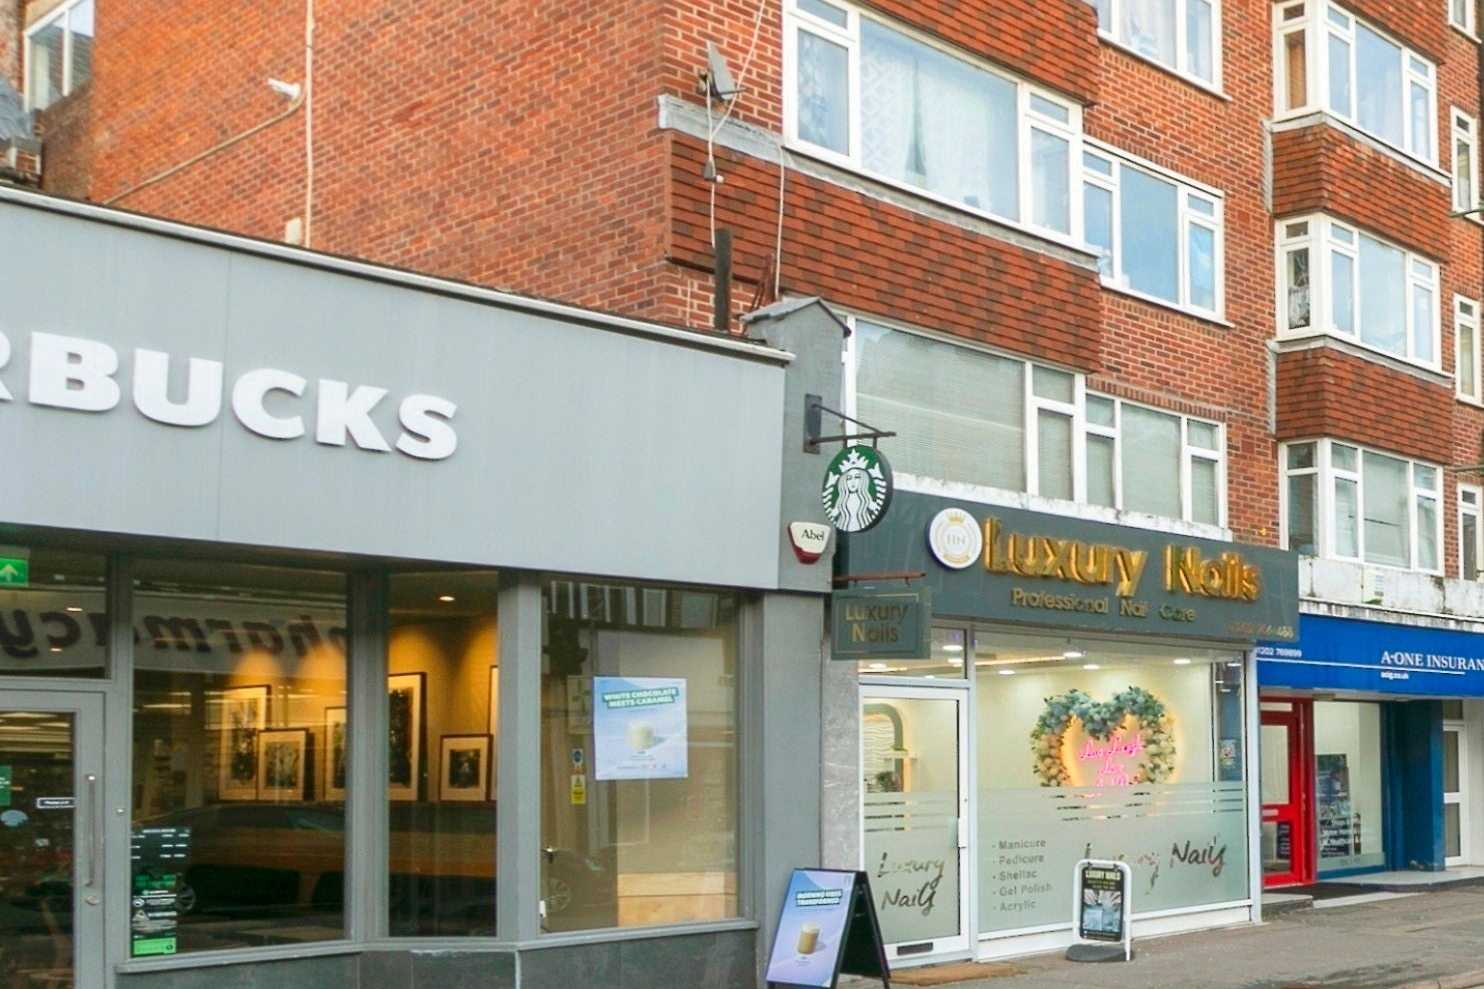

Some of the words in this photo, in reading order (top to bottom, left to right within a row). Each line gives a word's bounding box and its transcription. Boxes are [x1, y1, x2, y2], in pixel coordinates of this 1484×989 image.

[0, 331, 458, 461] BUCKS
[983, 517, 1148, 597] Luxury
[1165, 544, 1262, 602] Nails
[1011, 587, 1109, 615] Professional
[1158, 603, 1197, 623] Care
[844, 604, 909, 625] Luxury
[852, 623, 899, 643] Nails
[603, 692, 630, 701] WHITE
[631, 688, 677, 699] CHOCOLATE
[608, 699, 635, 708] MEETS
[636, 696, 673, 706] CARAMEL
[998, 838, 1046, 850] Manicure
[999, 853, 1045, 864] Pedicure
[999, 869, 1037, 881] Shellac
[1000, 886, 1017, 897] Gel
[1021, 882, 1053, 894] Polish
[1000, 899, 1037, 913] Acrylic
